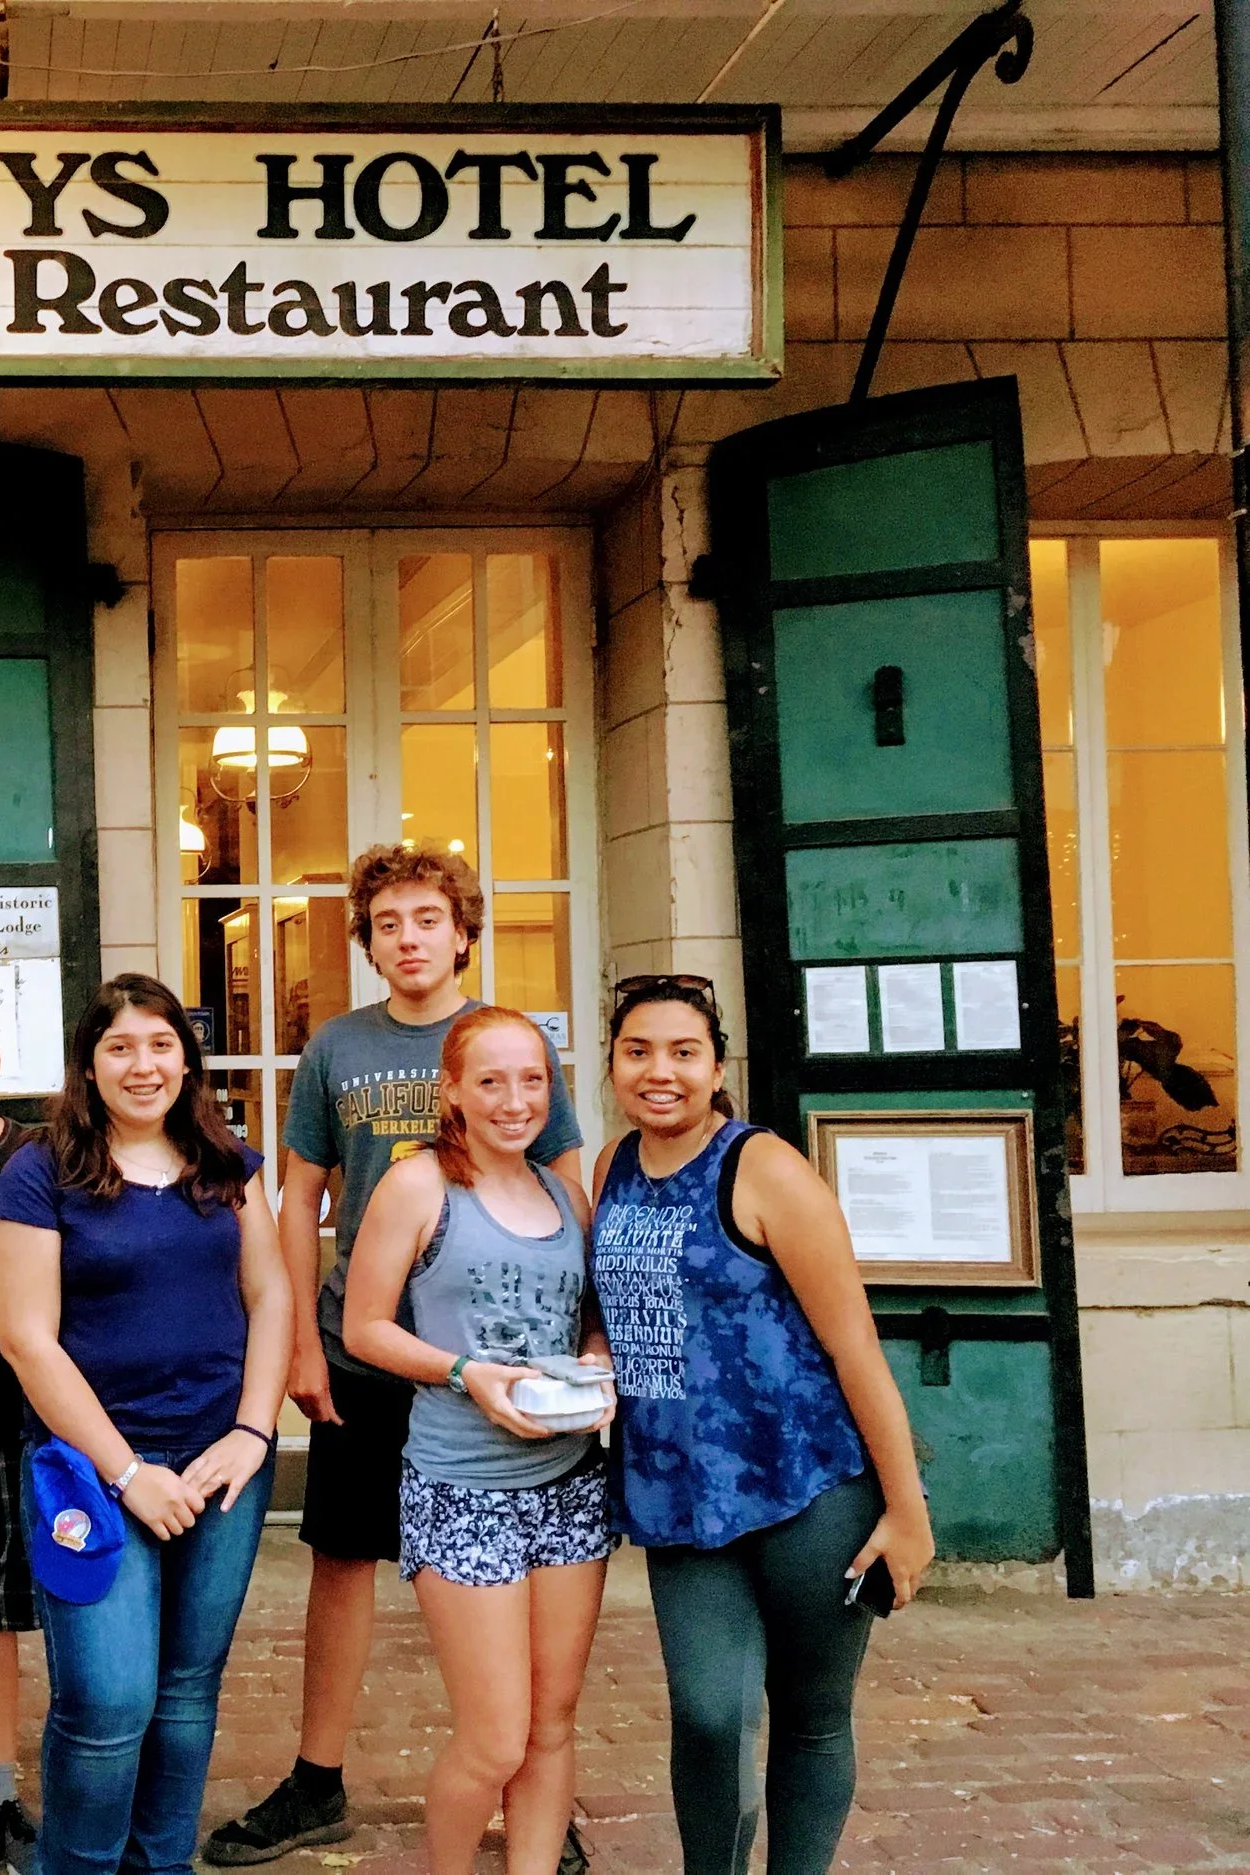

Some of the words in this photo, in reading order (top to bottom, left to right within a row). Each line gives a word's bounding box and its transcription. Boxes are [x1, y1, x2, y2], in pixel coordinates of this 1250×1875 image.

[254, 149, 697, 242] HOTEL
[3, 249, 629, 338] Restaurant
[340, 1068, 440, 1091] UNIVERSIT
[335, 1080, 441, 1130] CALIFOR
[597, 1229, 685, 1248] OBLIVIATE
[646, 1247, 683, 1257] MORTIS
[595, 1255, 678, 1274] RIDDIKULUS
